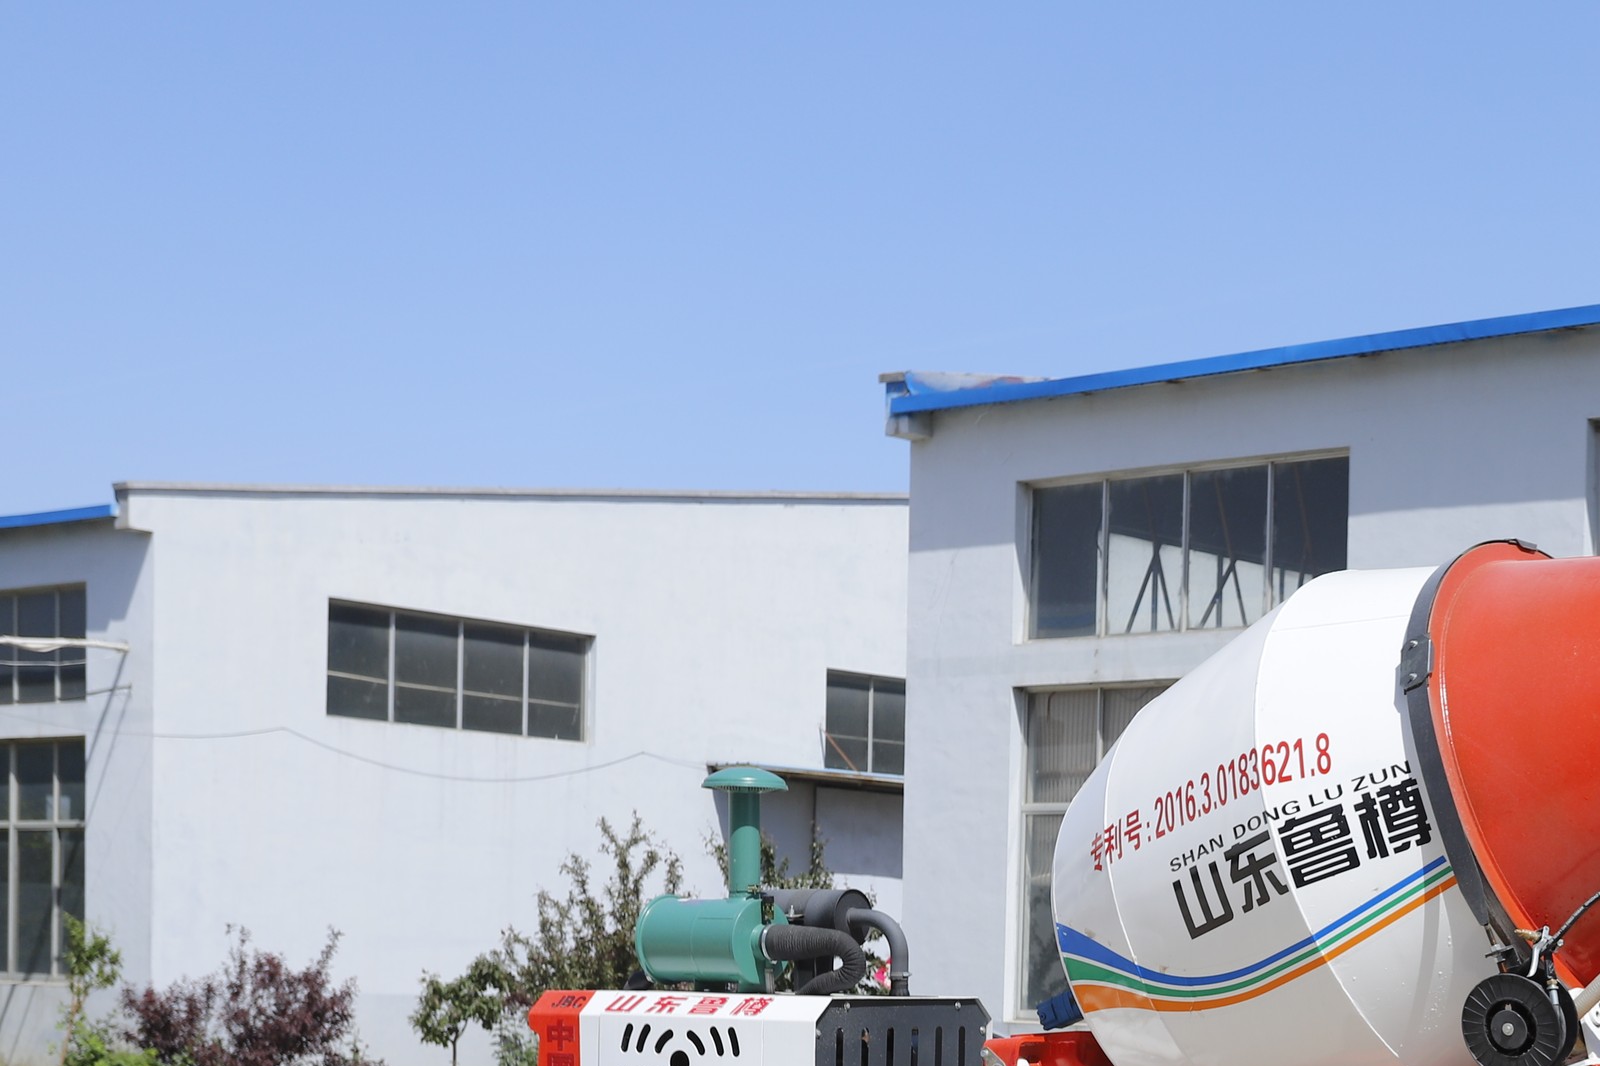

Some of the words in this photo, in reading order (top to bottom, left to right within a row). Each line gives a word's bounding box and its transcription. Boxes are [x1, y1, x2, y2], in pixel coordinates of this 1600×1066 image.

[1169, 838, 1224, 873] SHAN
[1233, 799, 1301, 840] DONG
[1310, 784, 1344, 809] LU
[1353, 760, 1412, 792] ZUN
[1172, 777, 1431, 940] 山东鲁樽
[551, 995, 587, 1009] JBC
